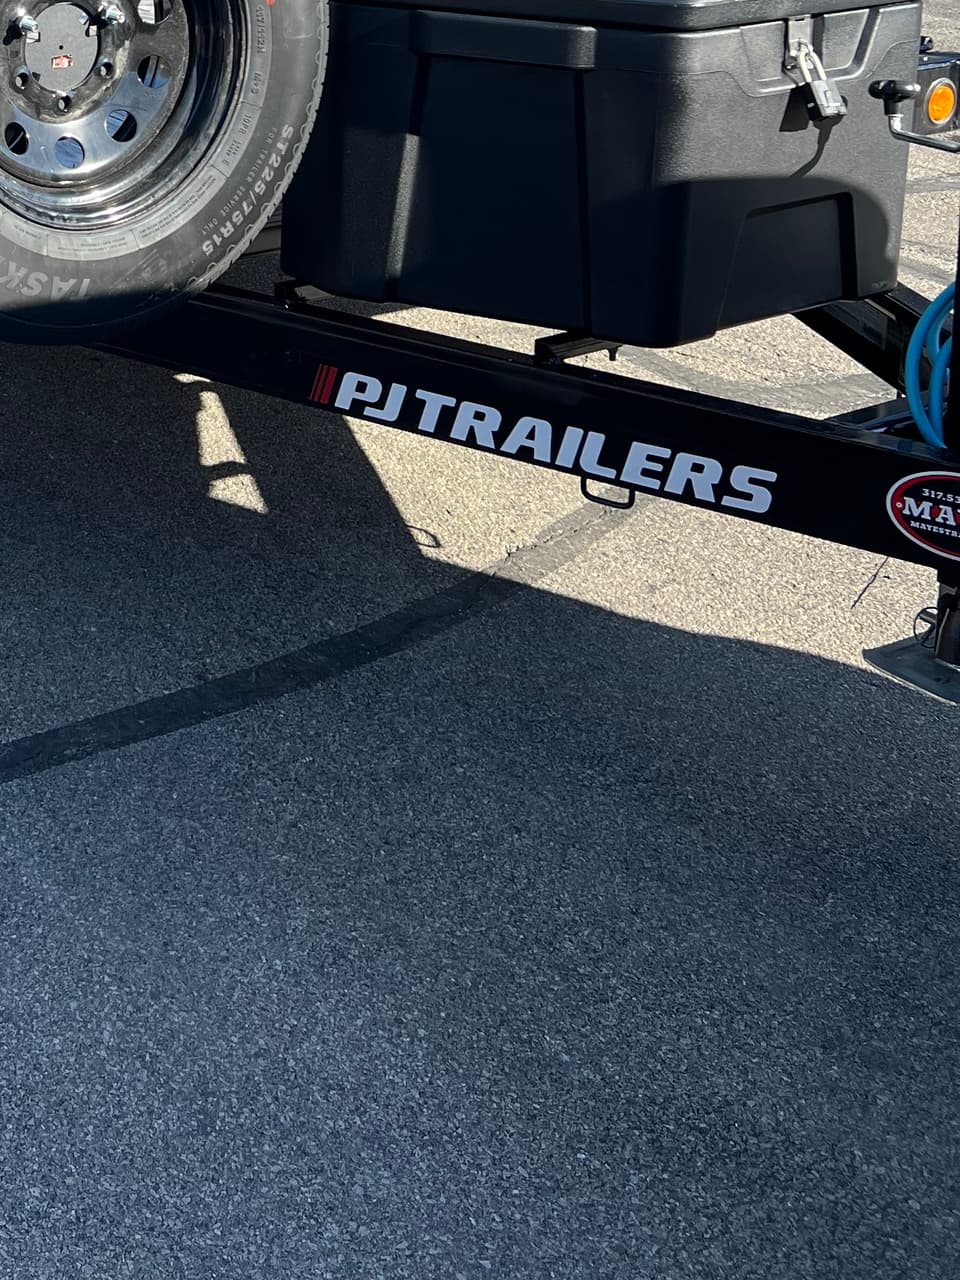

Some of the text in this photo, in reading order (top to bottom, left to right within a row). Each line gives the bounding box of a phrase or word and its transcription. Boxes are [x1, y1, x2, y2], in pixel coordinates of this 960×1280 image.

[202, 124, 294, 256] ST225/75R15
[335, 371, 778, 514] PJ TRAILERS
[902, 496, 960, 526] MA
